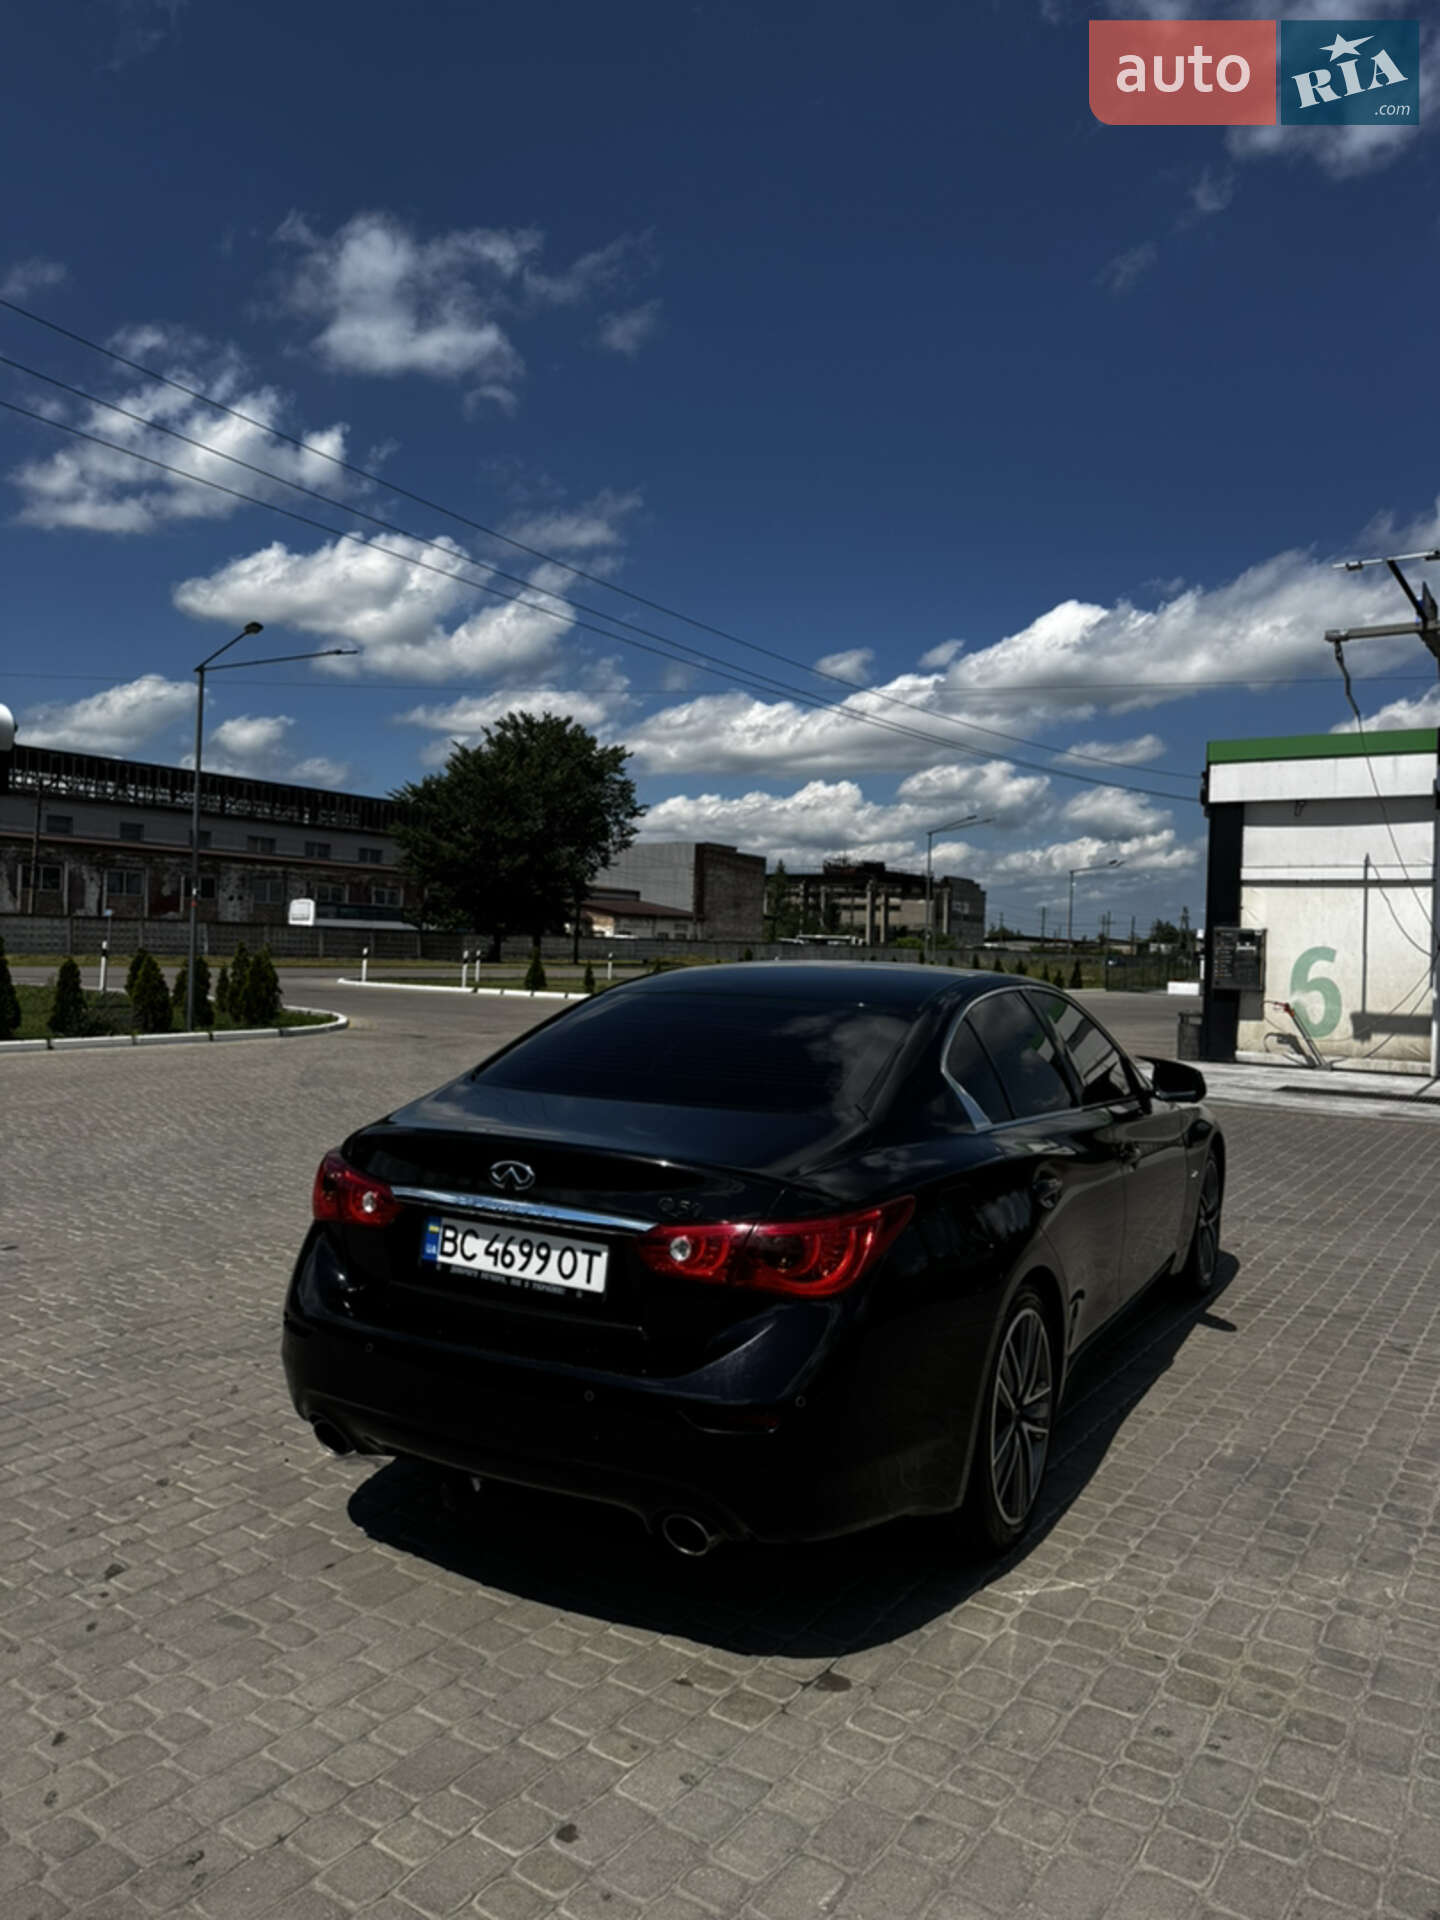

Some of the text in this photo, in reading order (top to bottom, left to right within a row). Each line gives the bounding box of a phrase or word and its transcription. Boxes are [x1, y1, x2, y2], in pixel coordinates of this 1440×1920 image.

[1290, 946, 1342, 1037] 6
[440, 1225, 480, 1262] BC
[484, 1233, 551, 1275] 4699
[557, 1246, 602, 1284] OT
